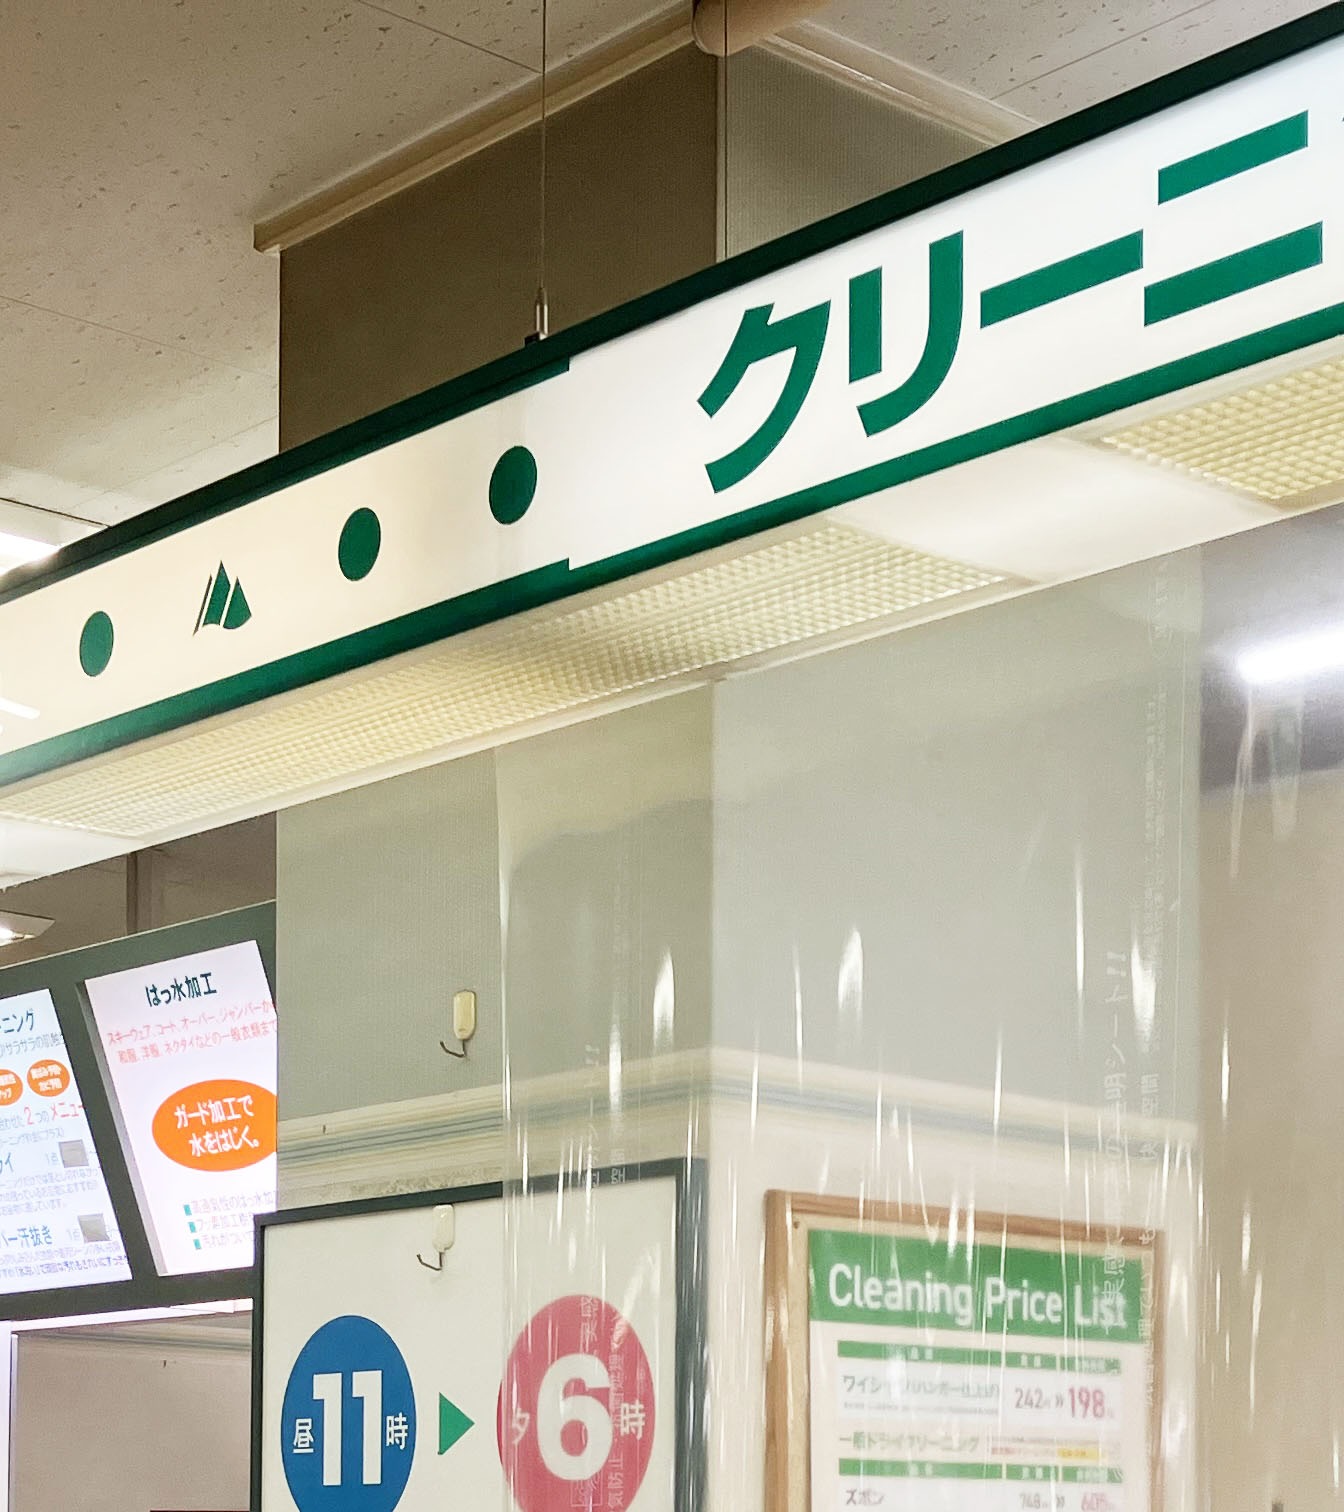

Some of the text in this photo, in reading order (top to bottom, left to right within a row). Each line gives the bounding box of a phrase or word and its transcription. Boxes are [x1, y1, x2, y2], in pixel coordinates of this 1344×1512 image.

[145, 972, 218, 1007] はっ水加工
[174, 1094, 254, 1129] ガード加工で
[188, 1126, 260, 1157] 水をはじく。
[828, 1263, 1127, 1329] Cleaning Price List
